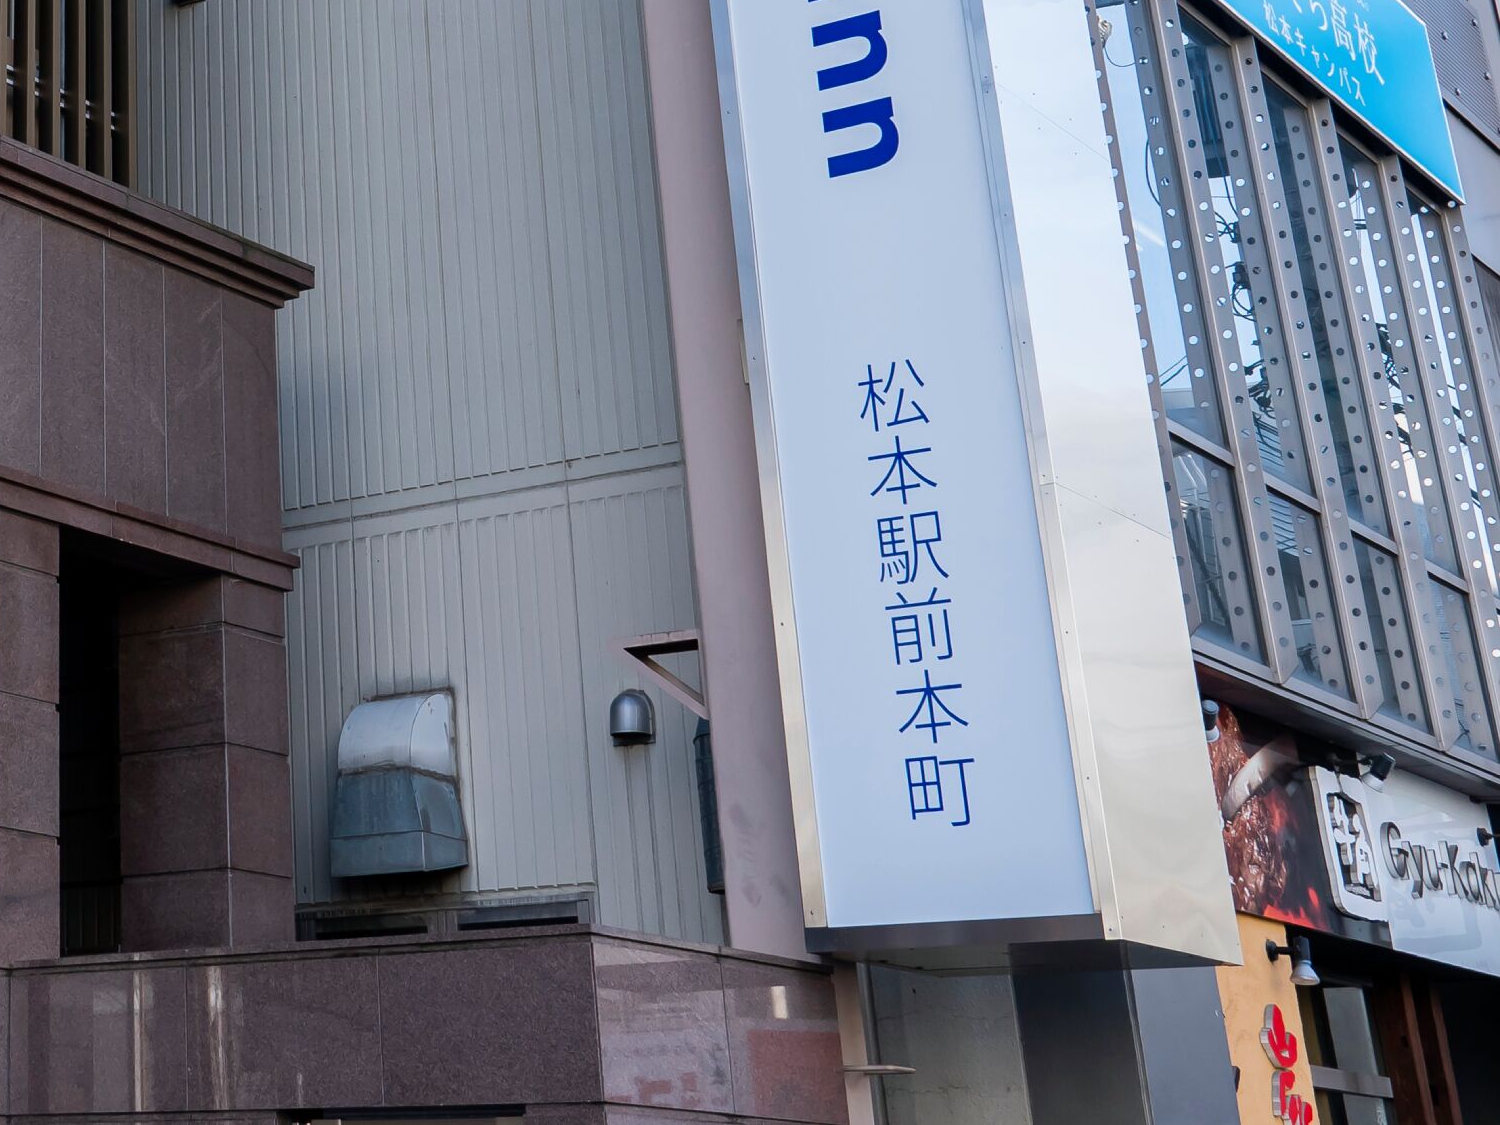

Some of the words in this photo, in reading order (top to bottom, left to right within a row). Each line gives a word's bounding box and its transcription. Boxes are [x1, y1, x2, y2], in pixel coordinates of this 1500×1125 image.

[857, 358, 975, 828] 松本駅前本町
